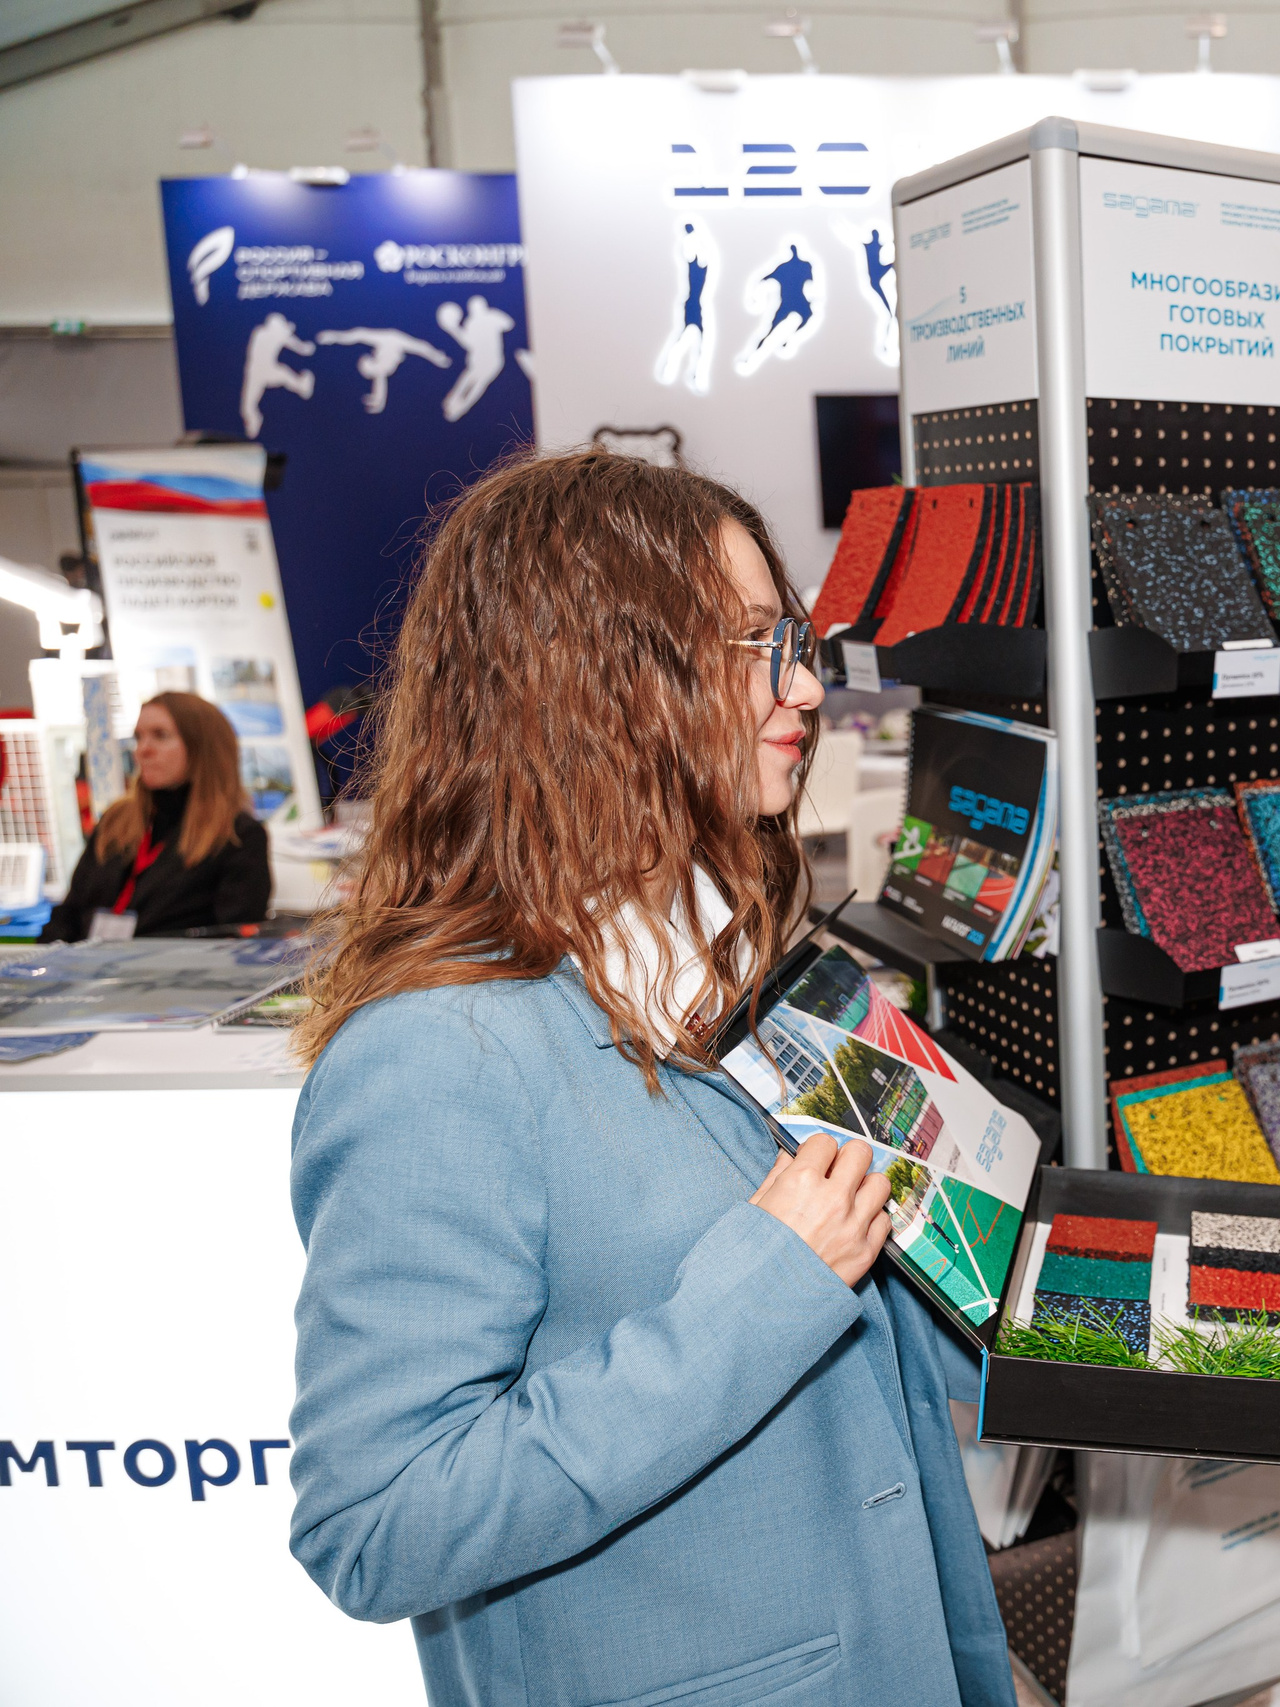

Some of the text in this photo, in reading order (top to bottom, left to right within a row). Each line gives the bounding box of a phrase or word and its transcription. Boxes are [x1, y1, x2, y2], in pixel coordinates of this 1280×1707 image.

[1102, 192, 1196, 219] sagama
[959, 285, 967, 304] 5
[910, 301, 1026, 343] ПРОИЗВОДСТВЕННЫХ
[1169, 304, 1265, 329] ГОТОВЫХ
[946, 334, 985, 364] ЛИНИЙ
[1160, 333, 1274, 359] ПОКРЫТИЙ
[0, 1438, 291, 1502] мторг
